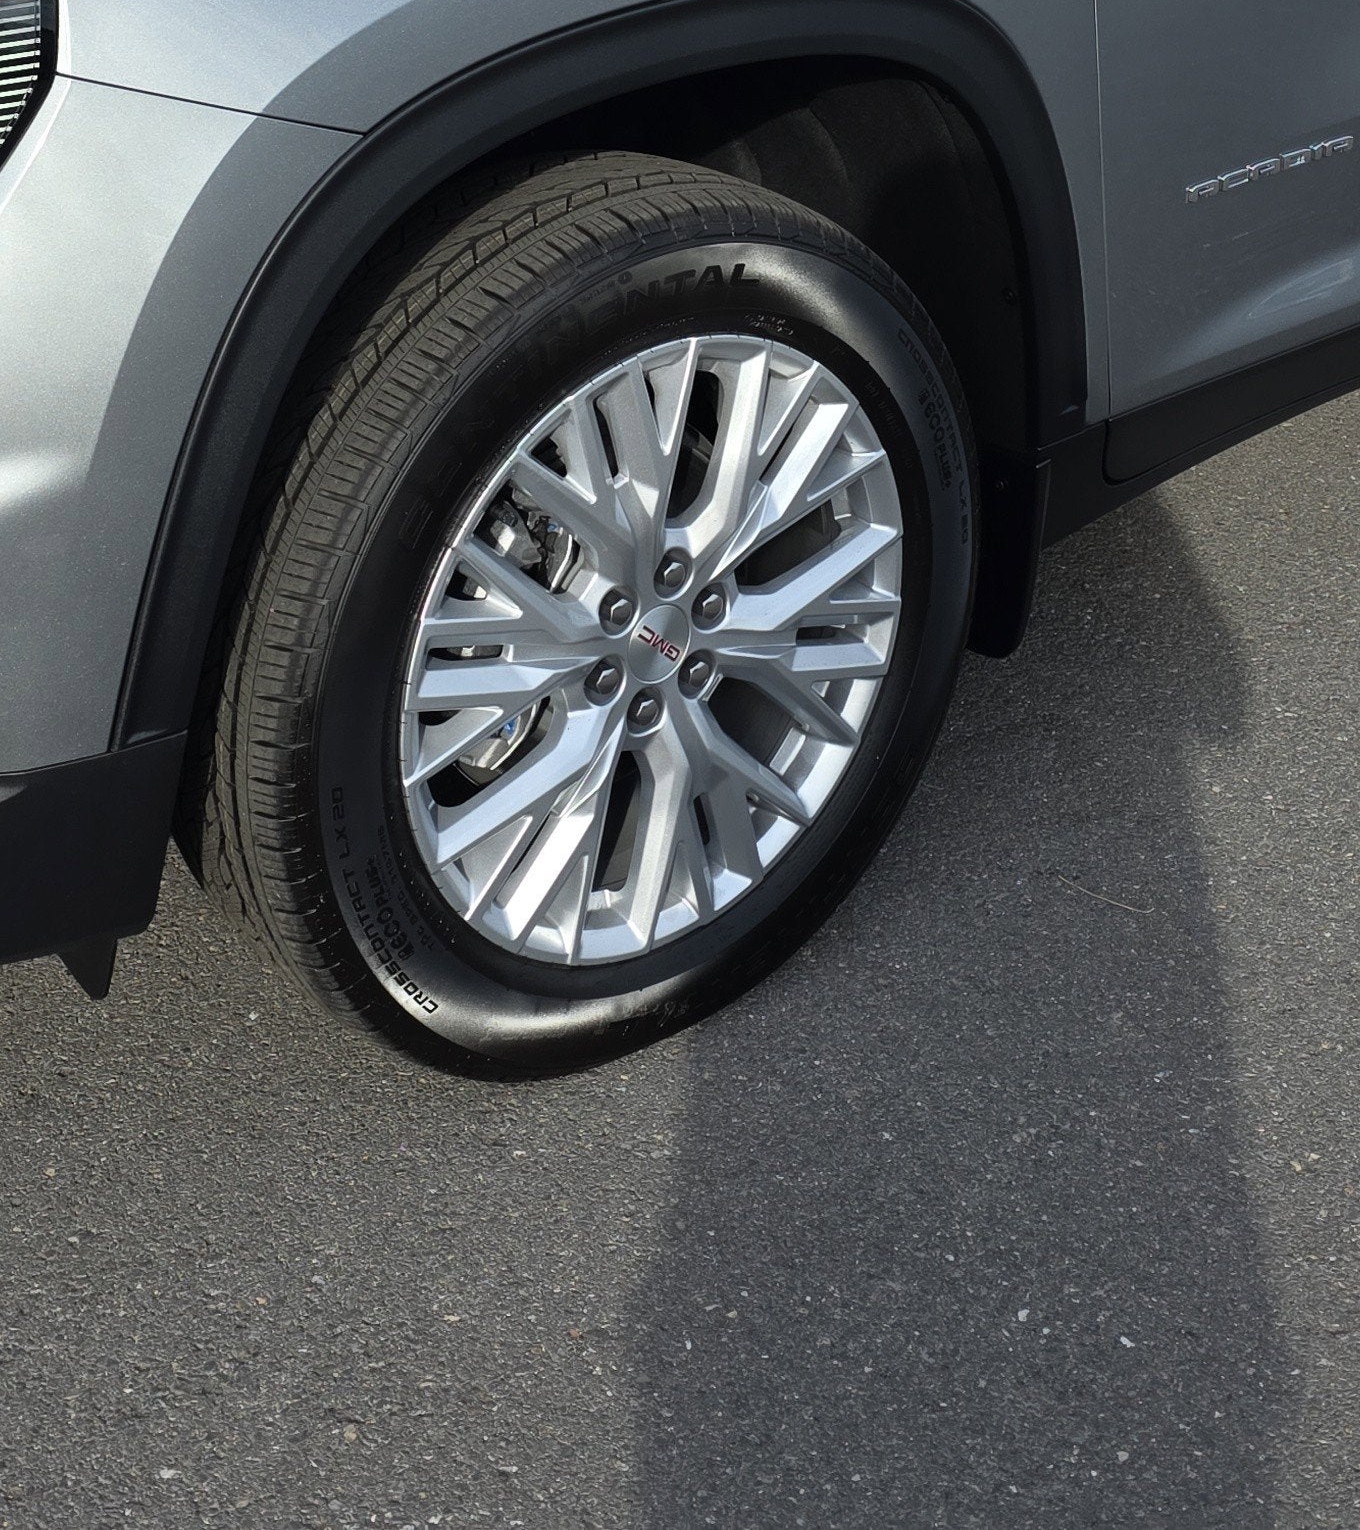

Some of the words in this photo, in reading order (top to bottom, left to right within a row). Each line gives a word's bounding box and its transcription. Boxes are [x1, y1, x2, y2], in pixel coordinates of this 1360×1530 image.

[1185, 135, 1355, 204] ACADIA
[637, 624, 681, 662] GMC
[330, 785, 346, 822] 20
[334, 825, 351, 860] LX
[342, 866, 439, 1015] CROSSCONTACT
